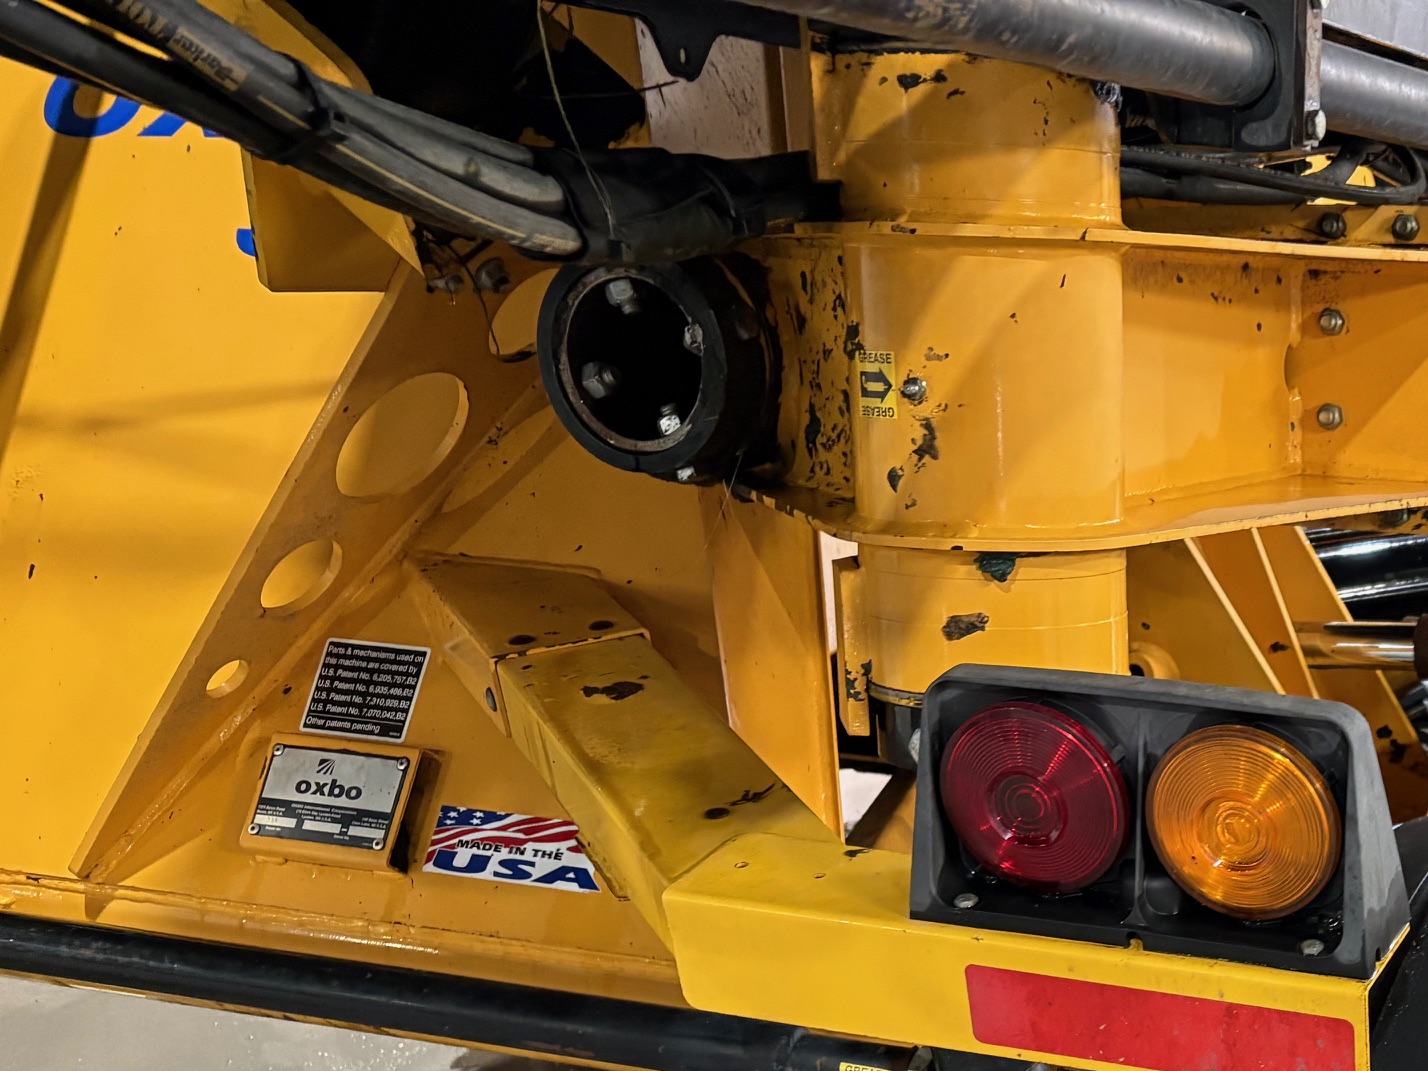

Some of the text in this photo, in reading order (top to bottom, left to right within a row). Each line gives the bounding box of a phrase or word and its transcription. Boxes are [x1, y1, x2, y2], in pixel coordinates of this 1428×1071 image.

[862, 406, 895, 418] GREASE
[328, 645, 345, 654] Parts
[346, 647, 352, 655] &
[353, 648, 395, 660] mechanisms
[396, 654, 414, 662] used
[321, 667, 334, 676] U.S.
[336, 669, 358, 679] Patent
[358, 672, 370, 680] No.
[325, 656, 337, 664] this
[338, 658, 367, 668] machine
[380, 663, 408, 672] covered
[408, 666, 418, 674] by
[318, 679, 331, 688] U.S.
[332, 680, 354, 691] Patent
[355, 684, 367, 692] No.
[314, 690, 328, 699] U.S.
[329, 692, 352, 702] Patent
[352, 695, 364, 704] No.
[310, 702, 324, 711] U.S.
[326, 704, 348, 714] Patent
[348, 706, 360, 716] No.
[306, 716, 380, 734] Other patents pending
[295, 779, 362, 800] oxbo
[456, 839, 565, 861] MADE IN THE
[432, 849, 600, 891] USA
